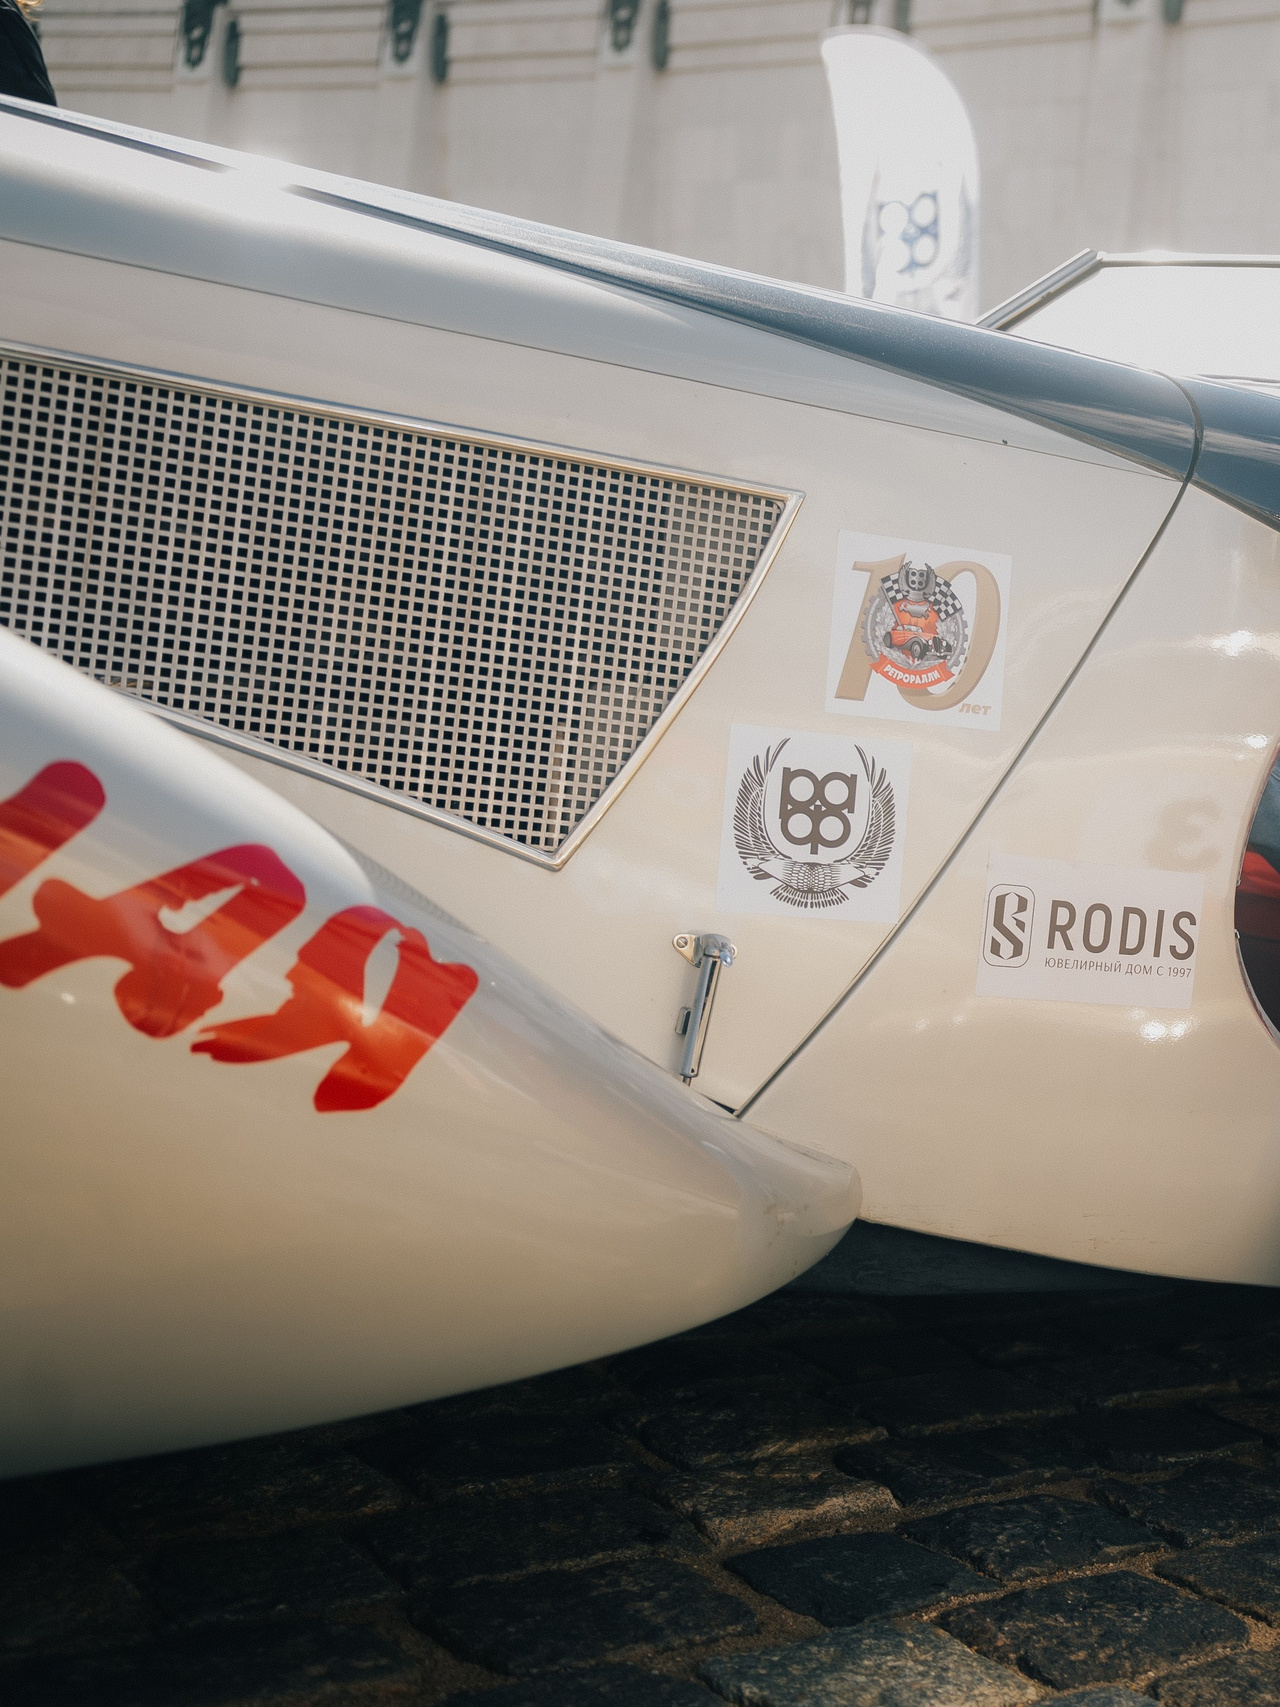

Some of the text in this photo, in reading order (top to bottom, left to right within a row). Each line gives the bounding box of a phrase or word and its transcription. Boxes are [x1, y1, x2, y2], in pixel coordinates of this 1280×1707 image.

[884, 664, 941, 685] РЕТРОРАЛЛИ
[959, 703, 992, 716] лет
[1047, 899, 1197, 961] RODIS
[1044, 957, 1122, 973] ЮВЕЛИРНЫЙ
[1125, 964, 1152, 977] ДОМ
[1168, 966, 1192, 978] 1997
